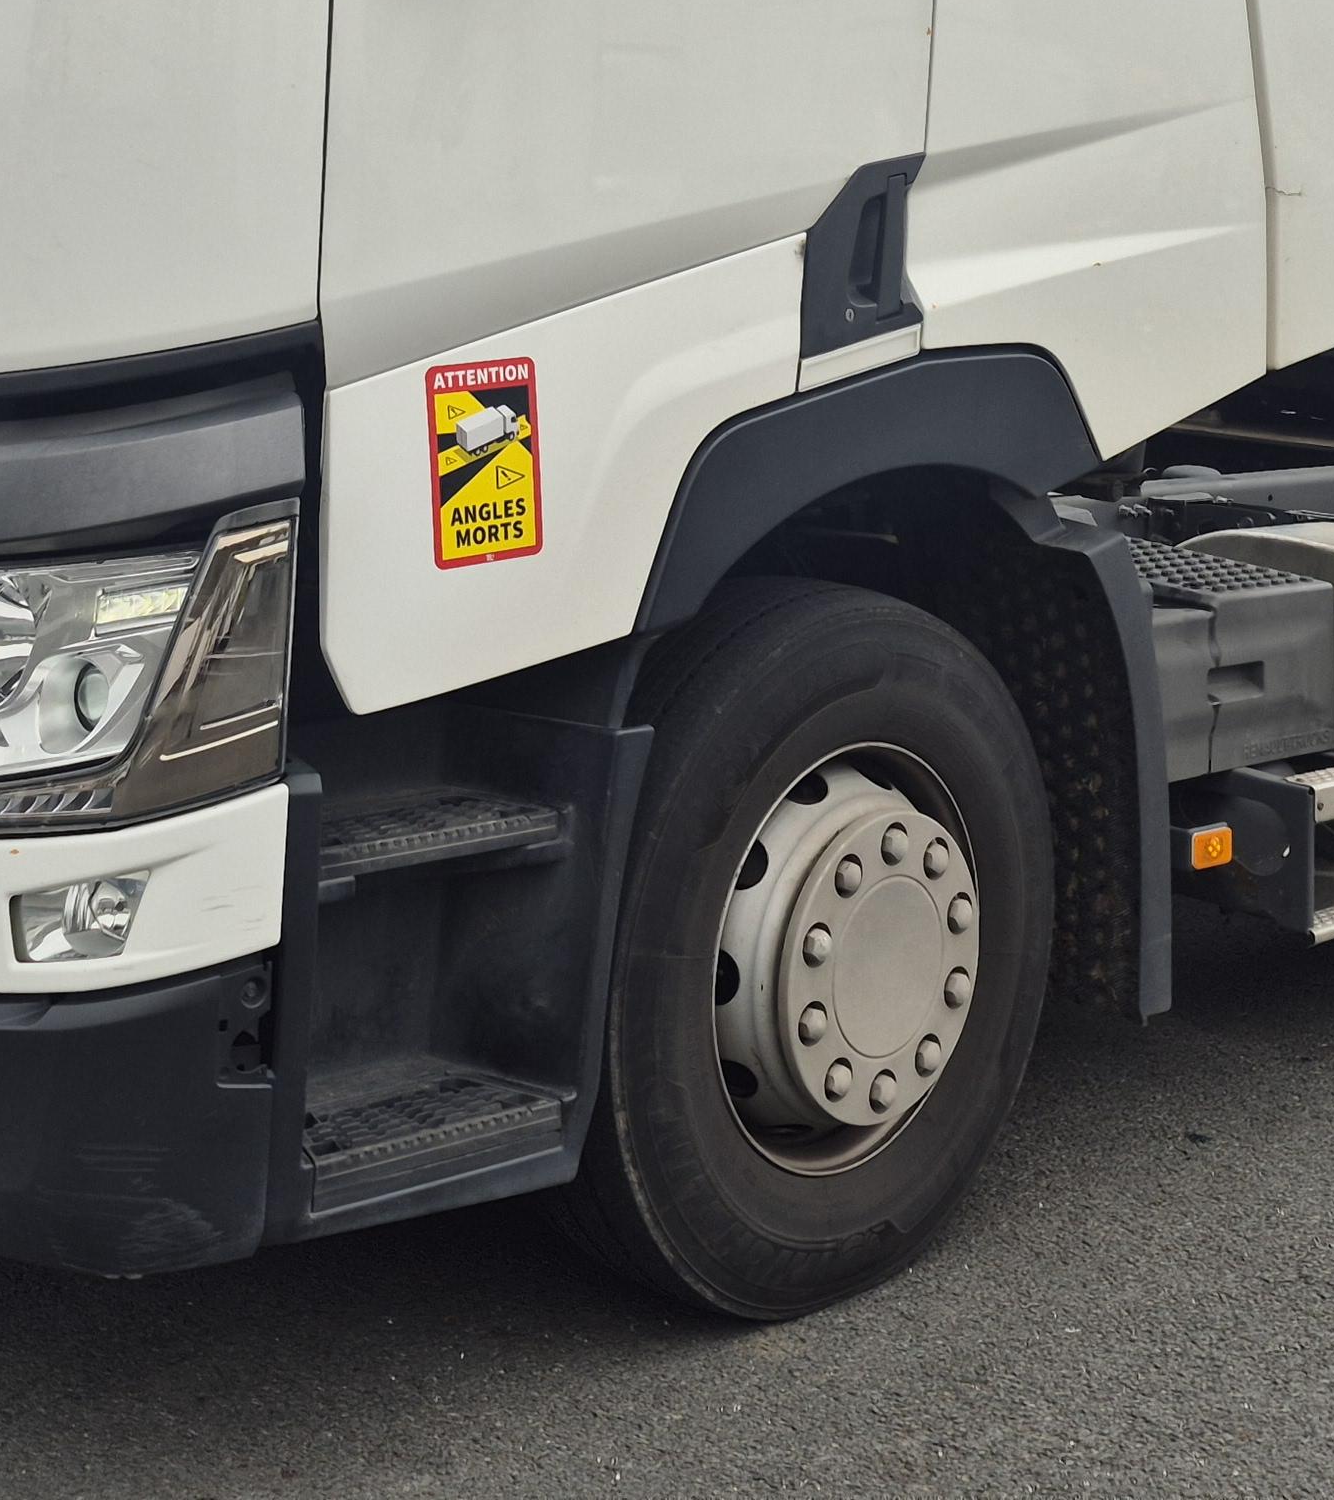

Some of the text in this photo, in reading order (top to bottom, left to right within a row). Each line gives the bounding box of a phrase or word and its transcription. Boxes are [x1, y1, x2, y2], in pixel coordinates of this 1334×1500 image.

[433, 363, 529, 389] ATTENTION
[450, 497, 527, 527] ANGLES
[455, 520, 524, 548] MORTS
